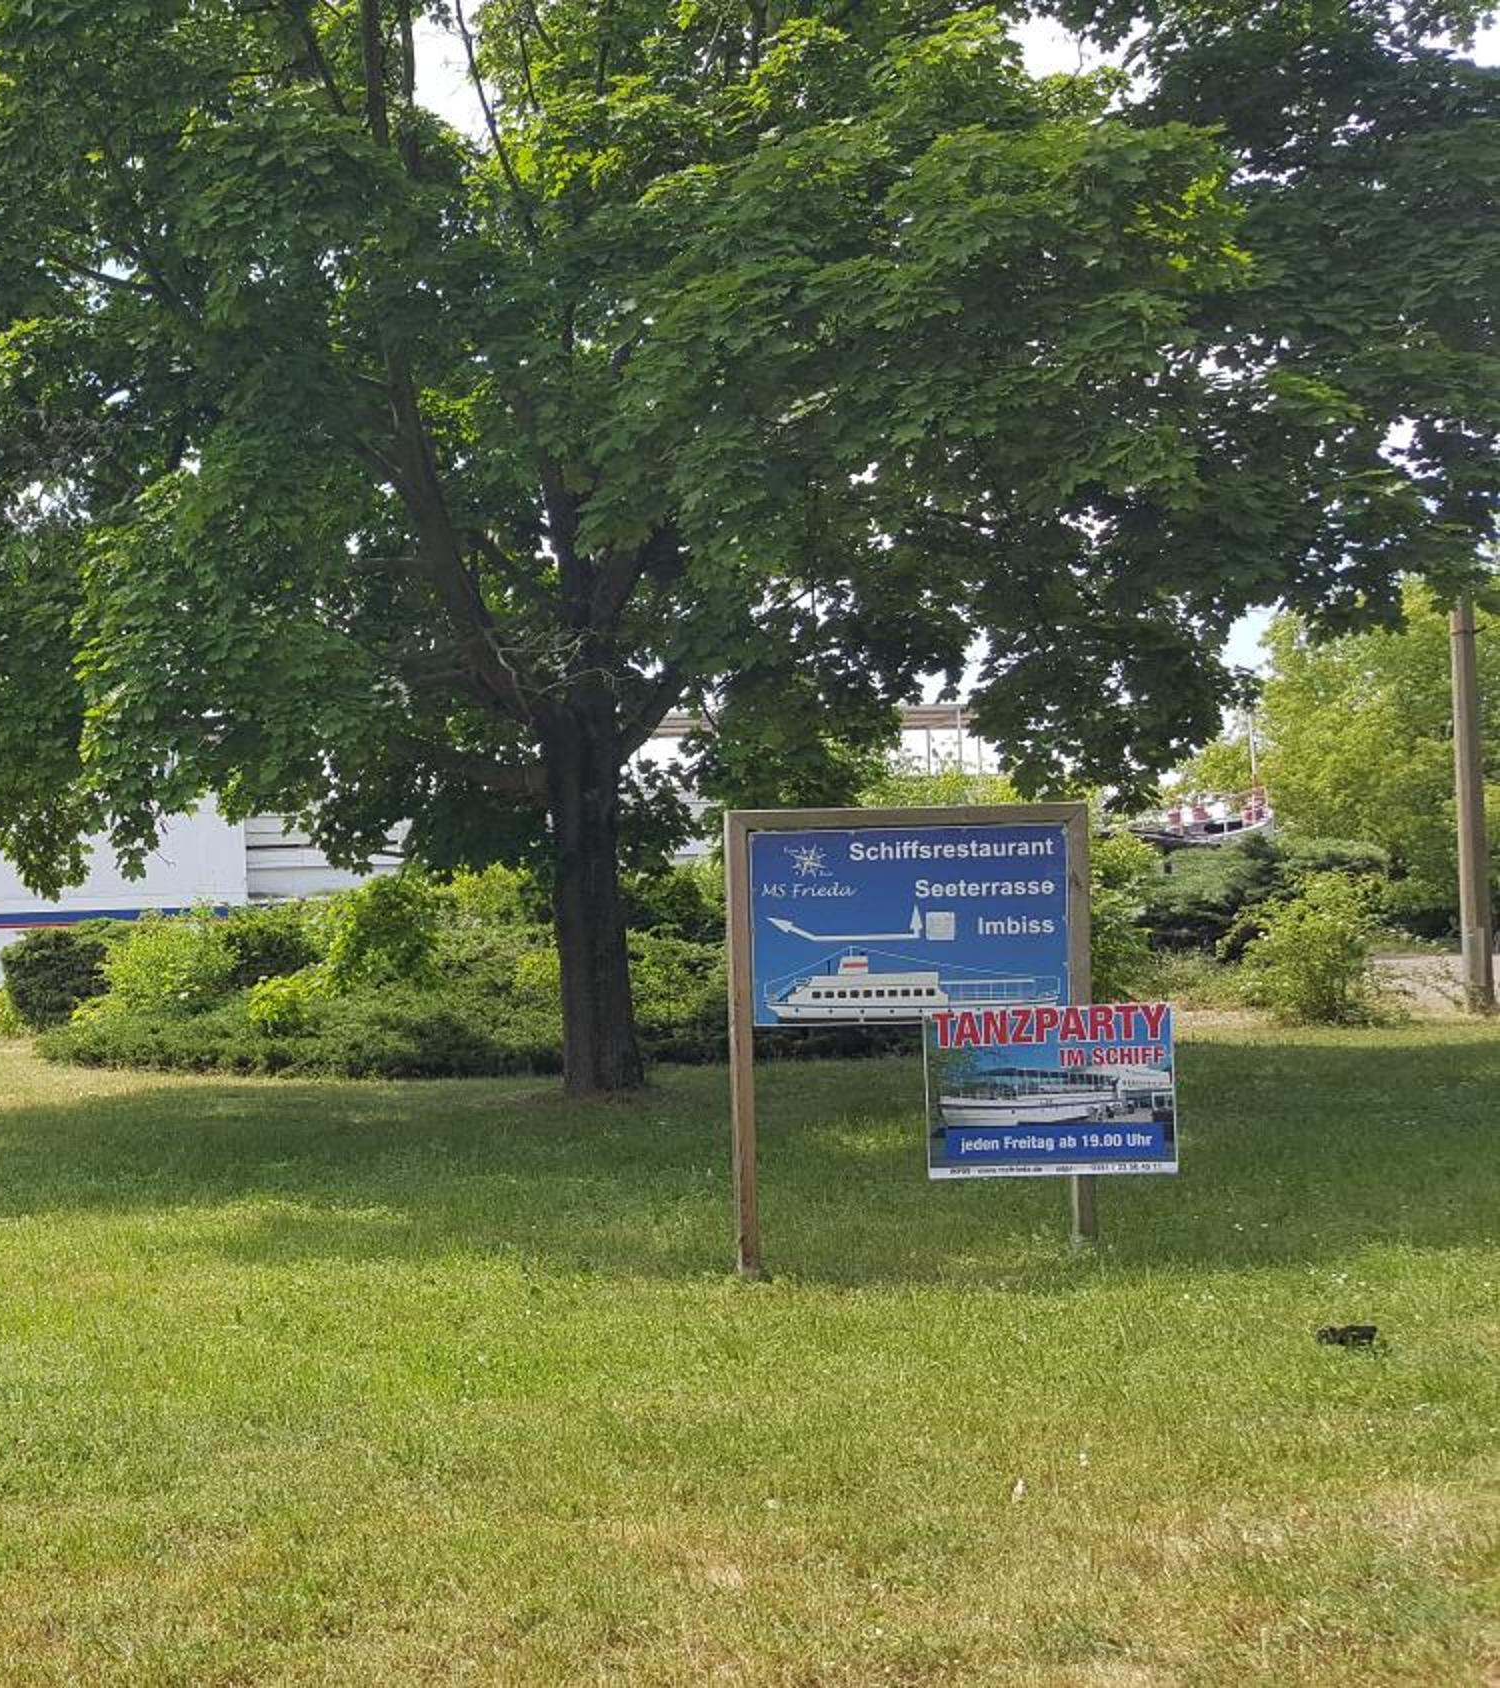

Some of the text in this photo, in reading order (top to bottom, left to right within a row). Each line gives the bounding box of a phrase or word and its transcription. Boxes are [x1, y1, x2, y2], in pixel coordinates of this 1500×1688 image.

[849, 837, 1055, 861] Schiffsrestaurant
[761, 881, 858, 899] MS Frieda
[914, 879, 1055, 898] Seeterrasse
[977, 915, 1055, 935] Imbiss
[932, 1003, 1167, 1048] TANZPARTY
[1059, 1046, 1165, 1067] IM SCHIFF
[960, 1133, 1153, 1154] jeden Freitag ab 19.00 Uhr
